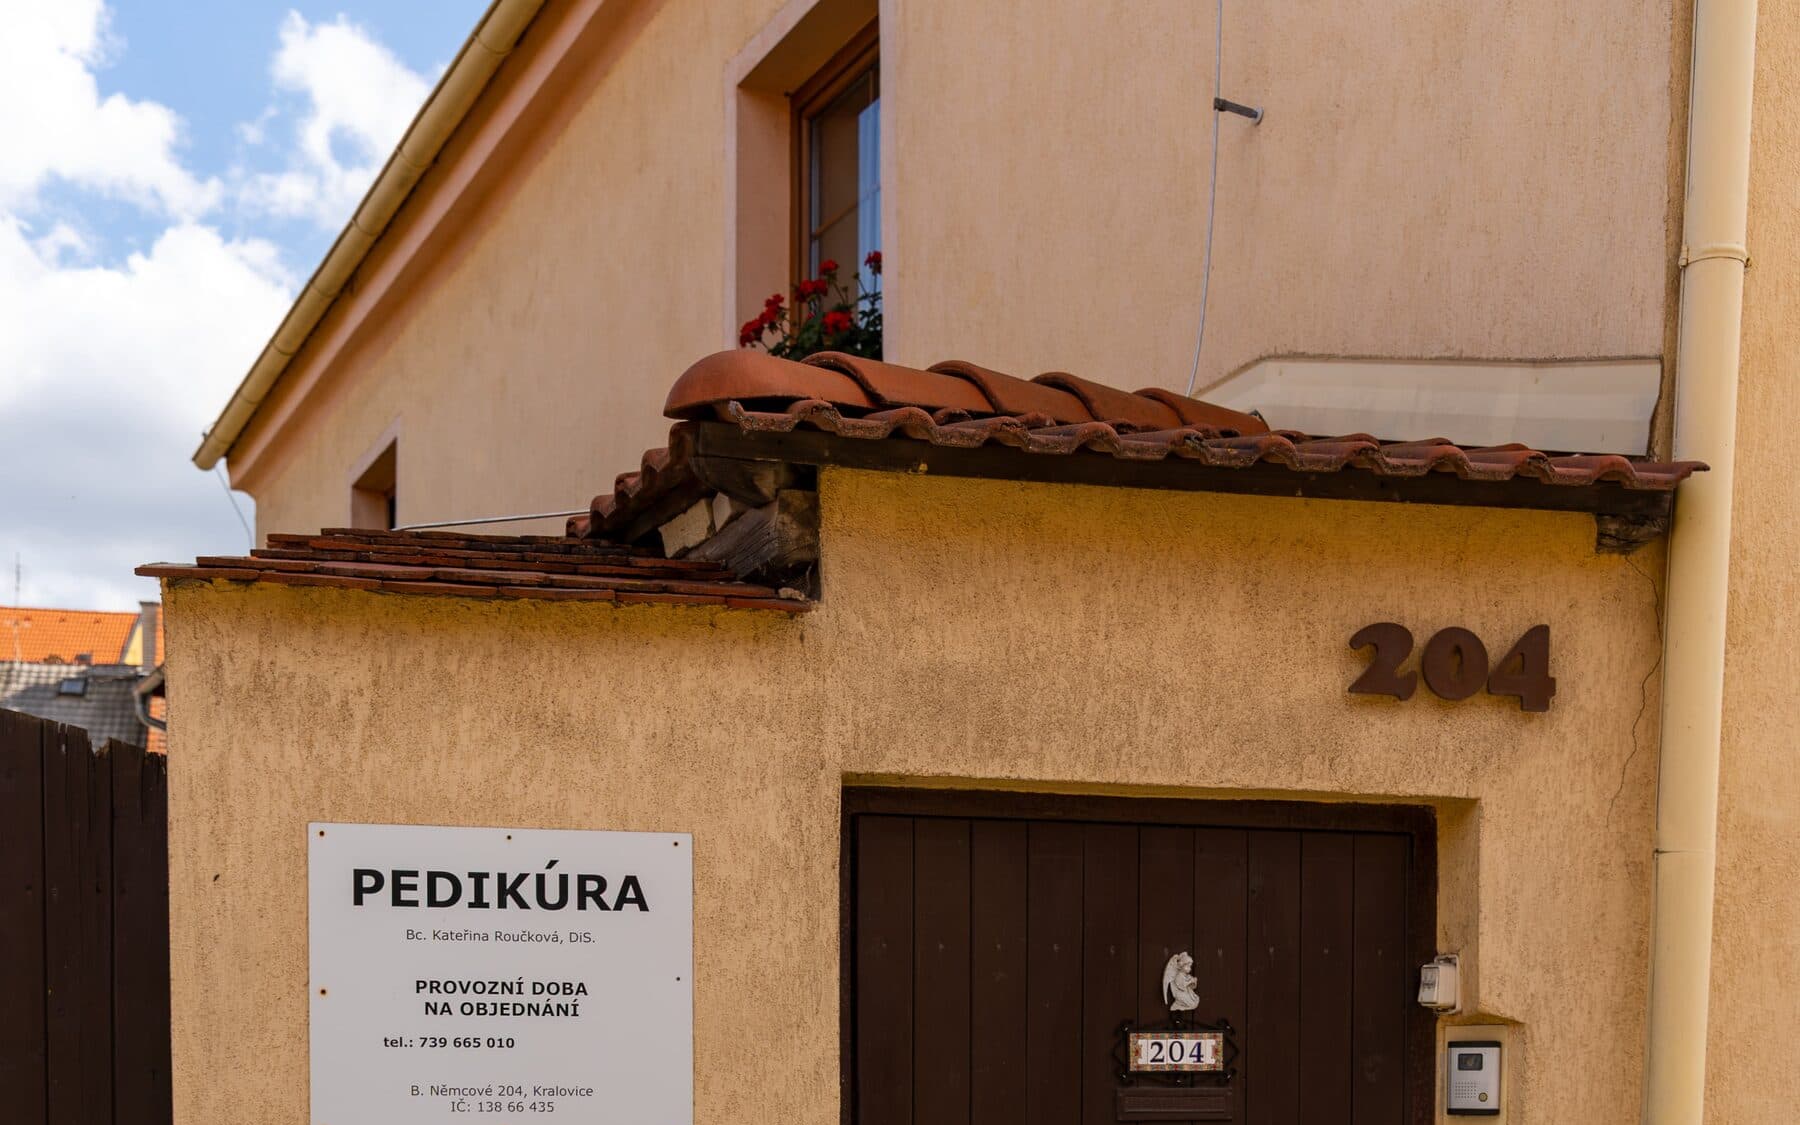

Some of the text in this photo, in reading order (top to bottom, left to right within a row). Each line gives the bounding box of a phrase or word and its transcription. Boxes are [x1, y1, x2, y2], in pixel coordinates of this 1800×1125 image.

[1348, 622, 1556, 712] 204
[352, 859, 650, 913] PEDIKÚRA
[405, 928, 596, 945] Bc. Kateřina Roučková, DiS.
[415, 976, 589, 997] PROVOZNÍ DOBA
[424, 997, 580, 1018] NA OBJEDNÁNÍ
[383, 1036, 516, 1049] tel.: 739 665 010
[1150, 1038, 1204, 1063] 204
[410, 1083, 594, 1099] B. Němcové 204, Kralovice
[450, 1099, 555, 1114] IČ: 138 66 435
